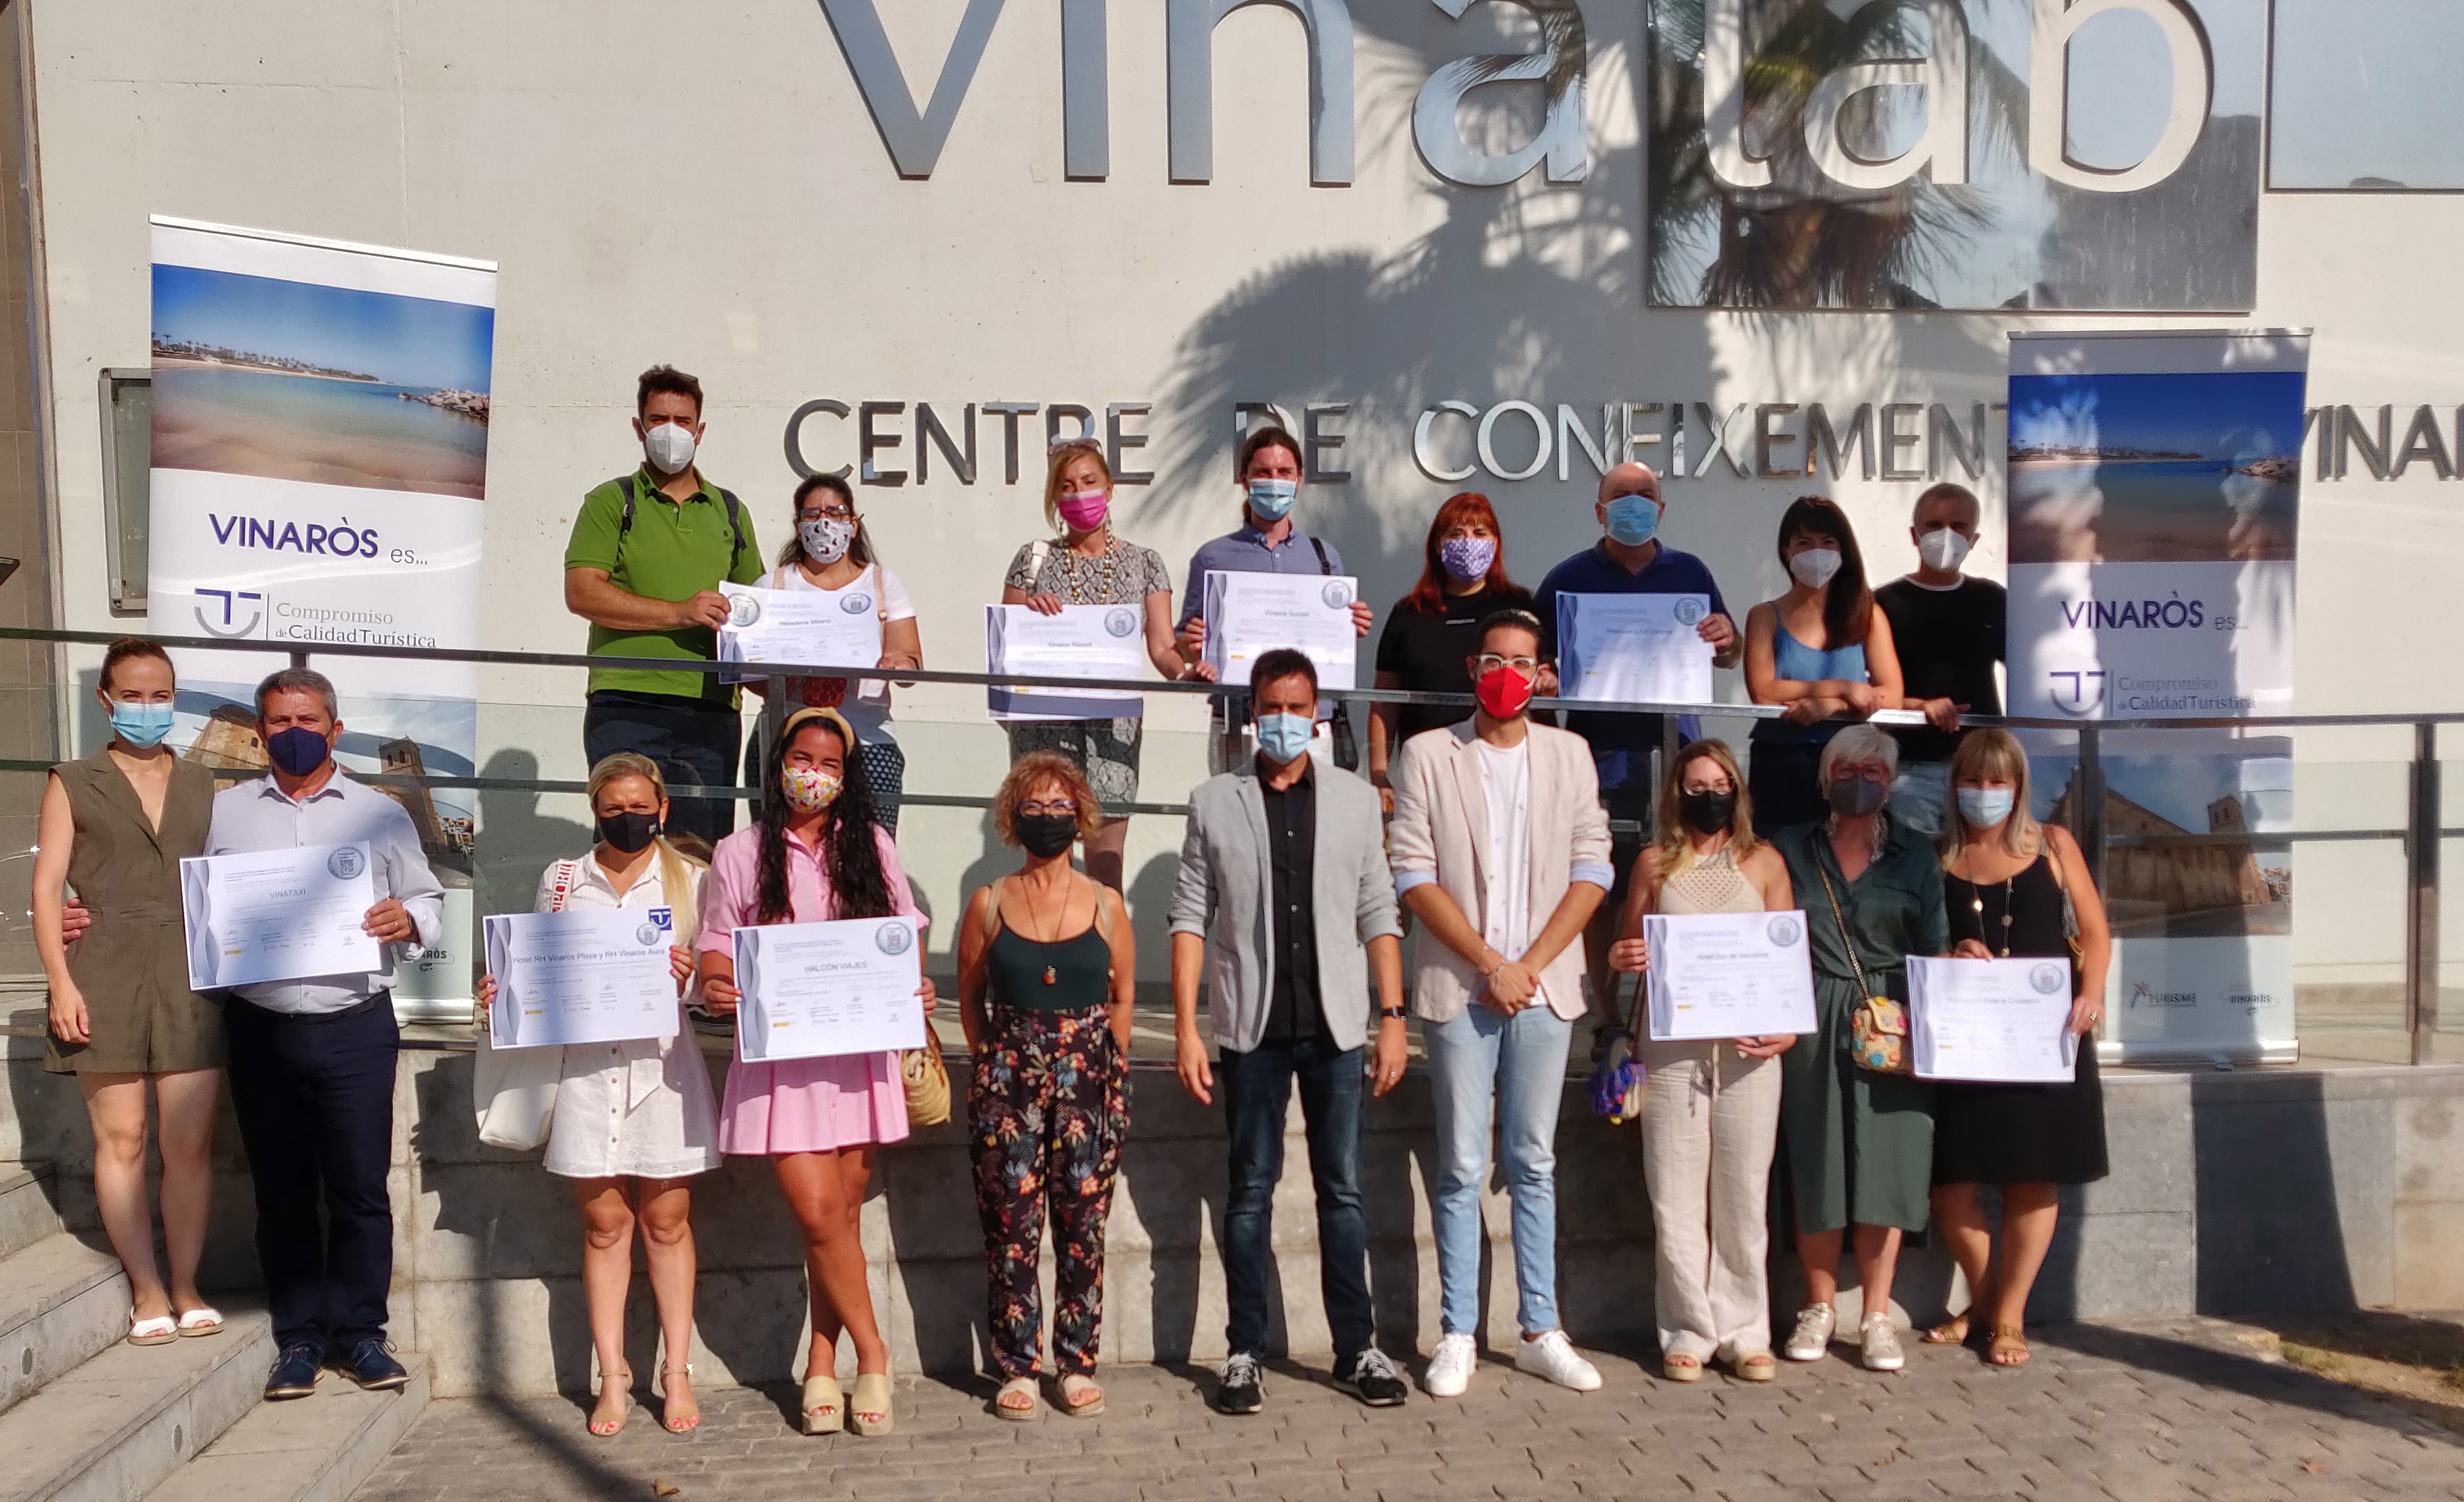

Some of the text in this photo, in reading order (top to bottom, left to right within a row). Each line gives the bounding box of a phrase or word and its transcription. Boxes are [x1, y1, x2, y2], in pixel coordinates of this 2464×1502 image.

[1413, 400, 2008, 482] CONEIXEMEN
[2301, 403, 2464, 482] INA
[209, 514, 428, 565] VINARÒS es...
[276, 603, 393, 624] Compromiso
[2061, 590, 2204, 629] VINARÒS
[275, 625, 436, 648] de Calidad Turística
